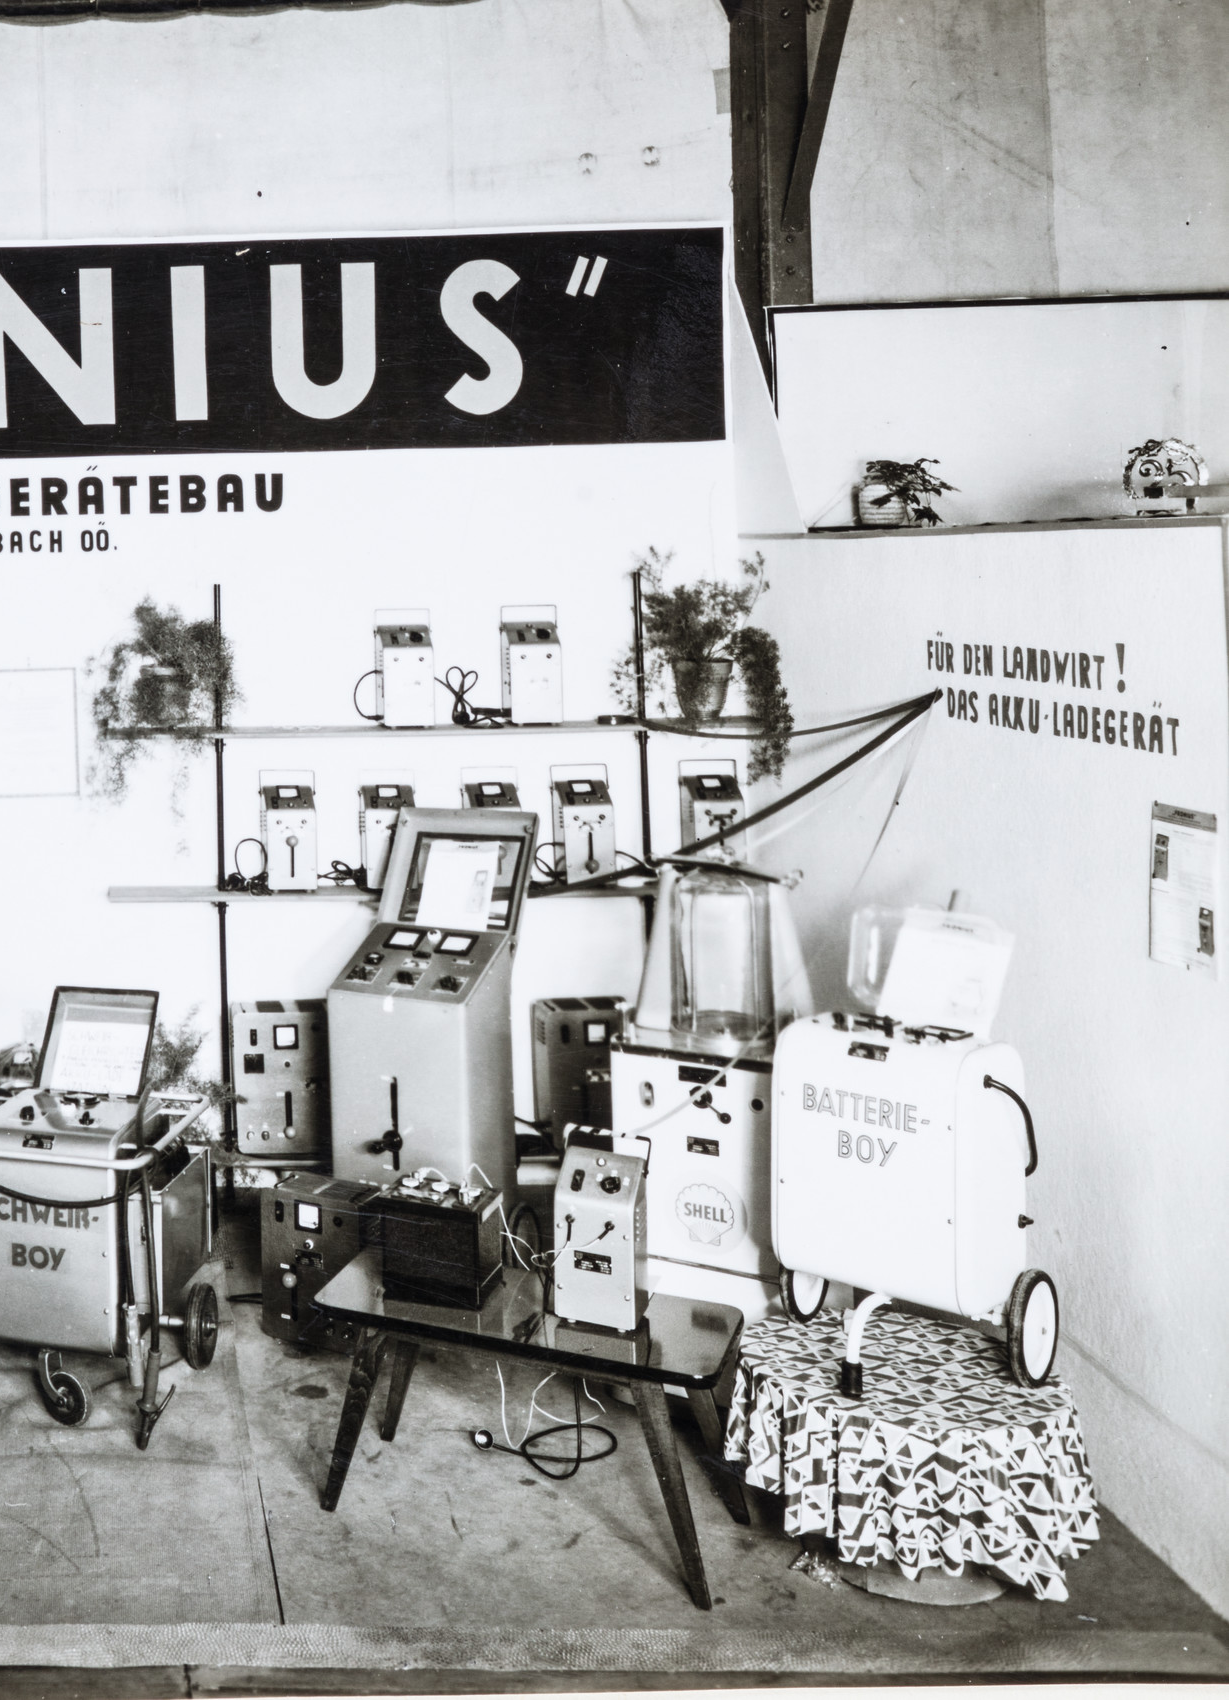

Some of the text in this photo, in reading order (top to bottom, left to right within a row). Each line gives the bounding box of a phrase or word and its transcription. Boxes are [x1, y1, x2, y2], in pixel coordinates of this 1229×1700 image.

[926, 631, 955, 674] FÜR
[963, 643, 994, 677] DEN
[946, 686, 1180, 756] DAS AKKU-LADEGERÄT
[802, 1083, 930, 1134] BATTERIE-
[837, 1129, 898, 1167] BOY
[684, 1202, 728, 1224] SHELL
[11, 1243, 66, 1271] BOY
